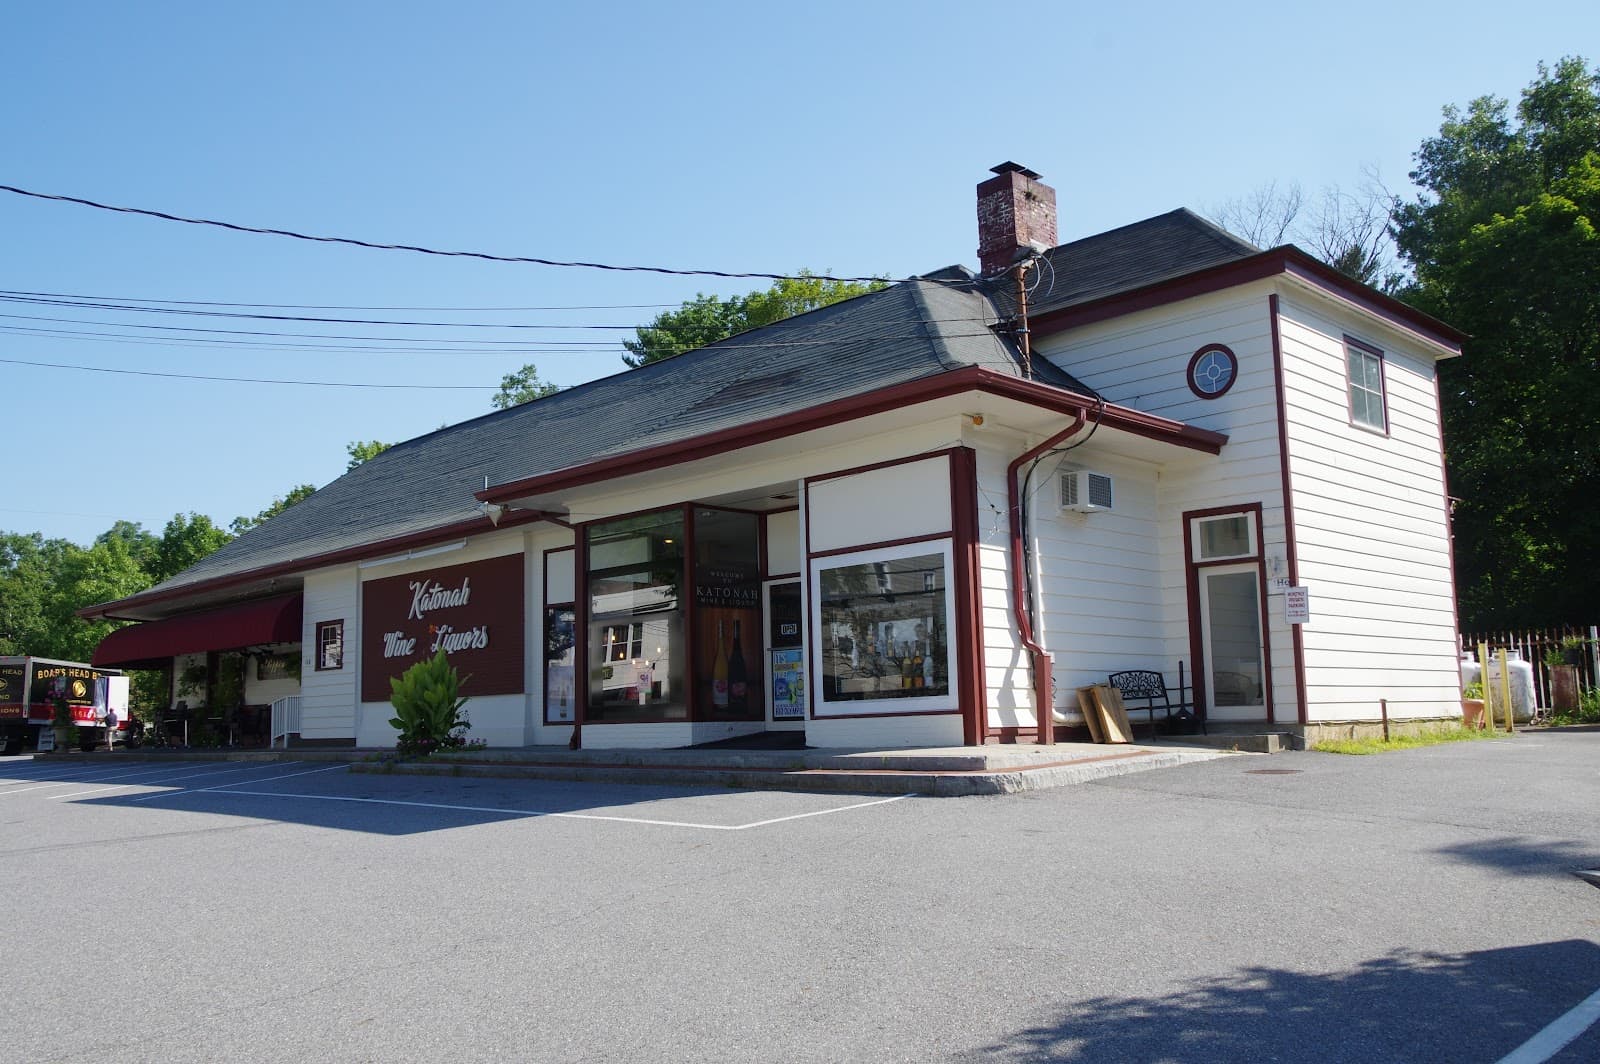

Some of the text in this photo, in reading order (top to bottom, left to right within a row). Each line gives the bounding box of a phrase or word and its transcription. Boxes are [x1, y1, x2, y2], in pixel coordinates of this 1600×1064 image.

[408, 577, 471, 620] Katonah
[696, 586, 758, 599] KATONAH
[383, 624, 489, 658] Wine Liquors
[37, 668, 66, 680] BOAR'S
[69, 668, 90, 679] HEAD
